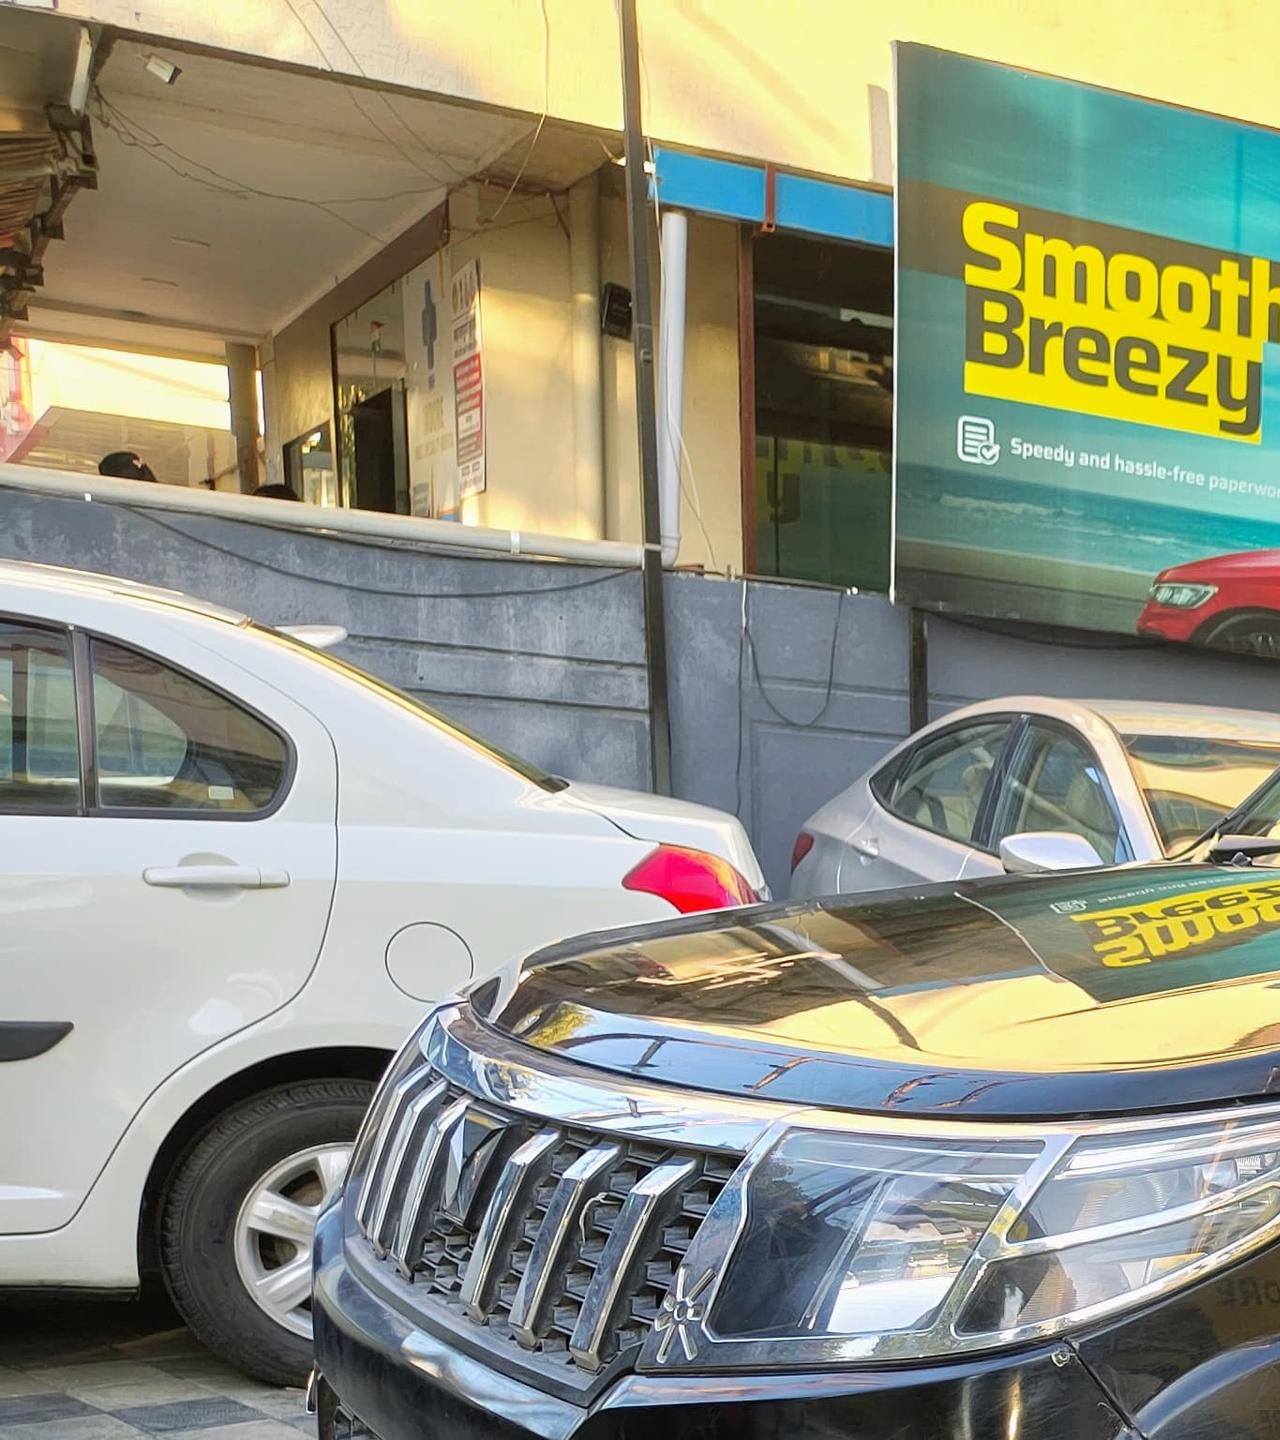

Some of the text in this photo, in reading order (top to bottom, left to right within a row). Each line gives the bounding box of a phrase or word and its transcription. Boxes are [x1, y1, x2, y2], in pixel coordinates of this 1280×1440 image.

[965, 284, 1262, 435] Breezy
[1010, 437, 1075, 467] Speedy
[1079, 451, 1110, 470] and
[1114, 454, 1205, 486] hassle-free
